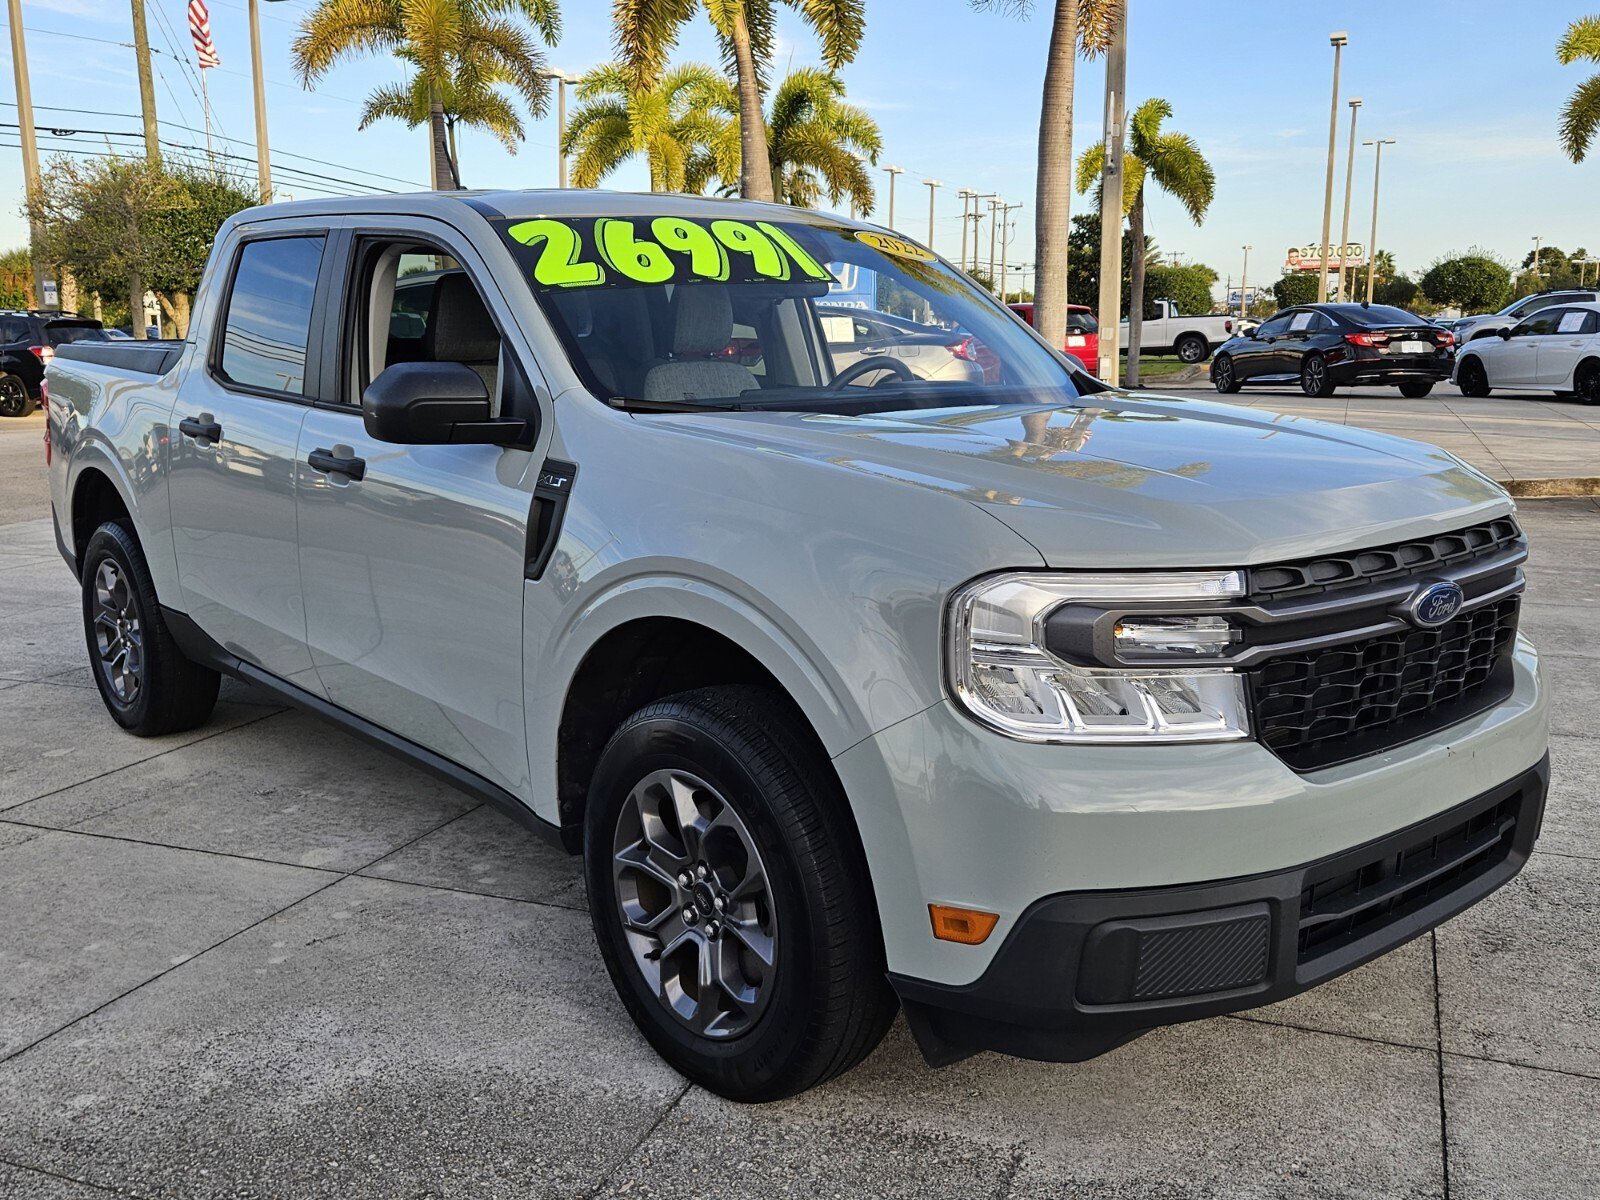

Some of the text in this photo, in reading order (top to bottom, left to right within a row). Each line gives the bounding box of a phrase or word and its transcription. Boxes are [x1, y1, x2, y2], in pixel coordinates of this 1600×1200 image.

[508, 217, 831, 288] 26991
[869, 235, 925, 257] 2022
[537, 473, 567, 488] XLT
[1428, 592, 1456, 618] Ford
